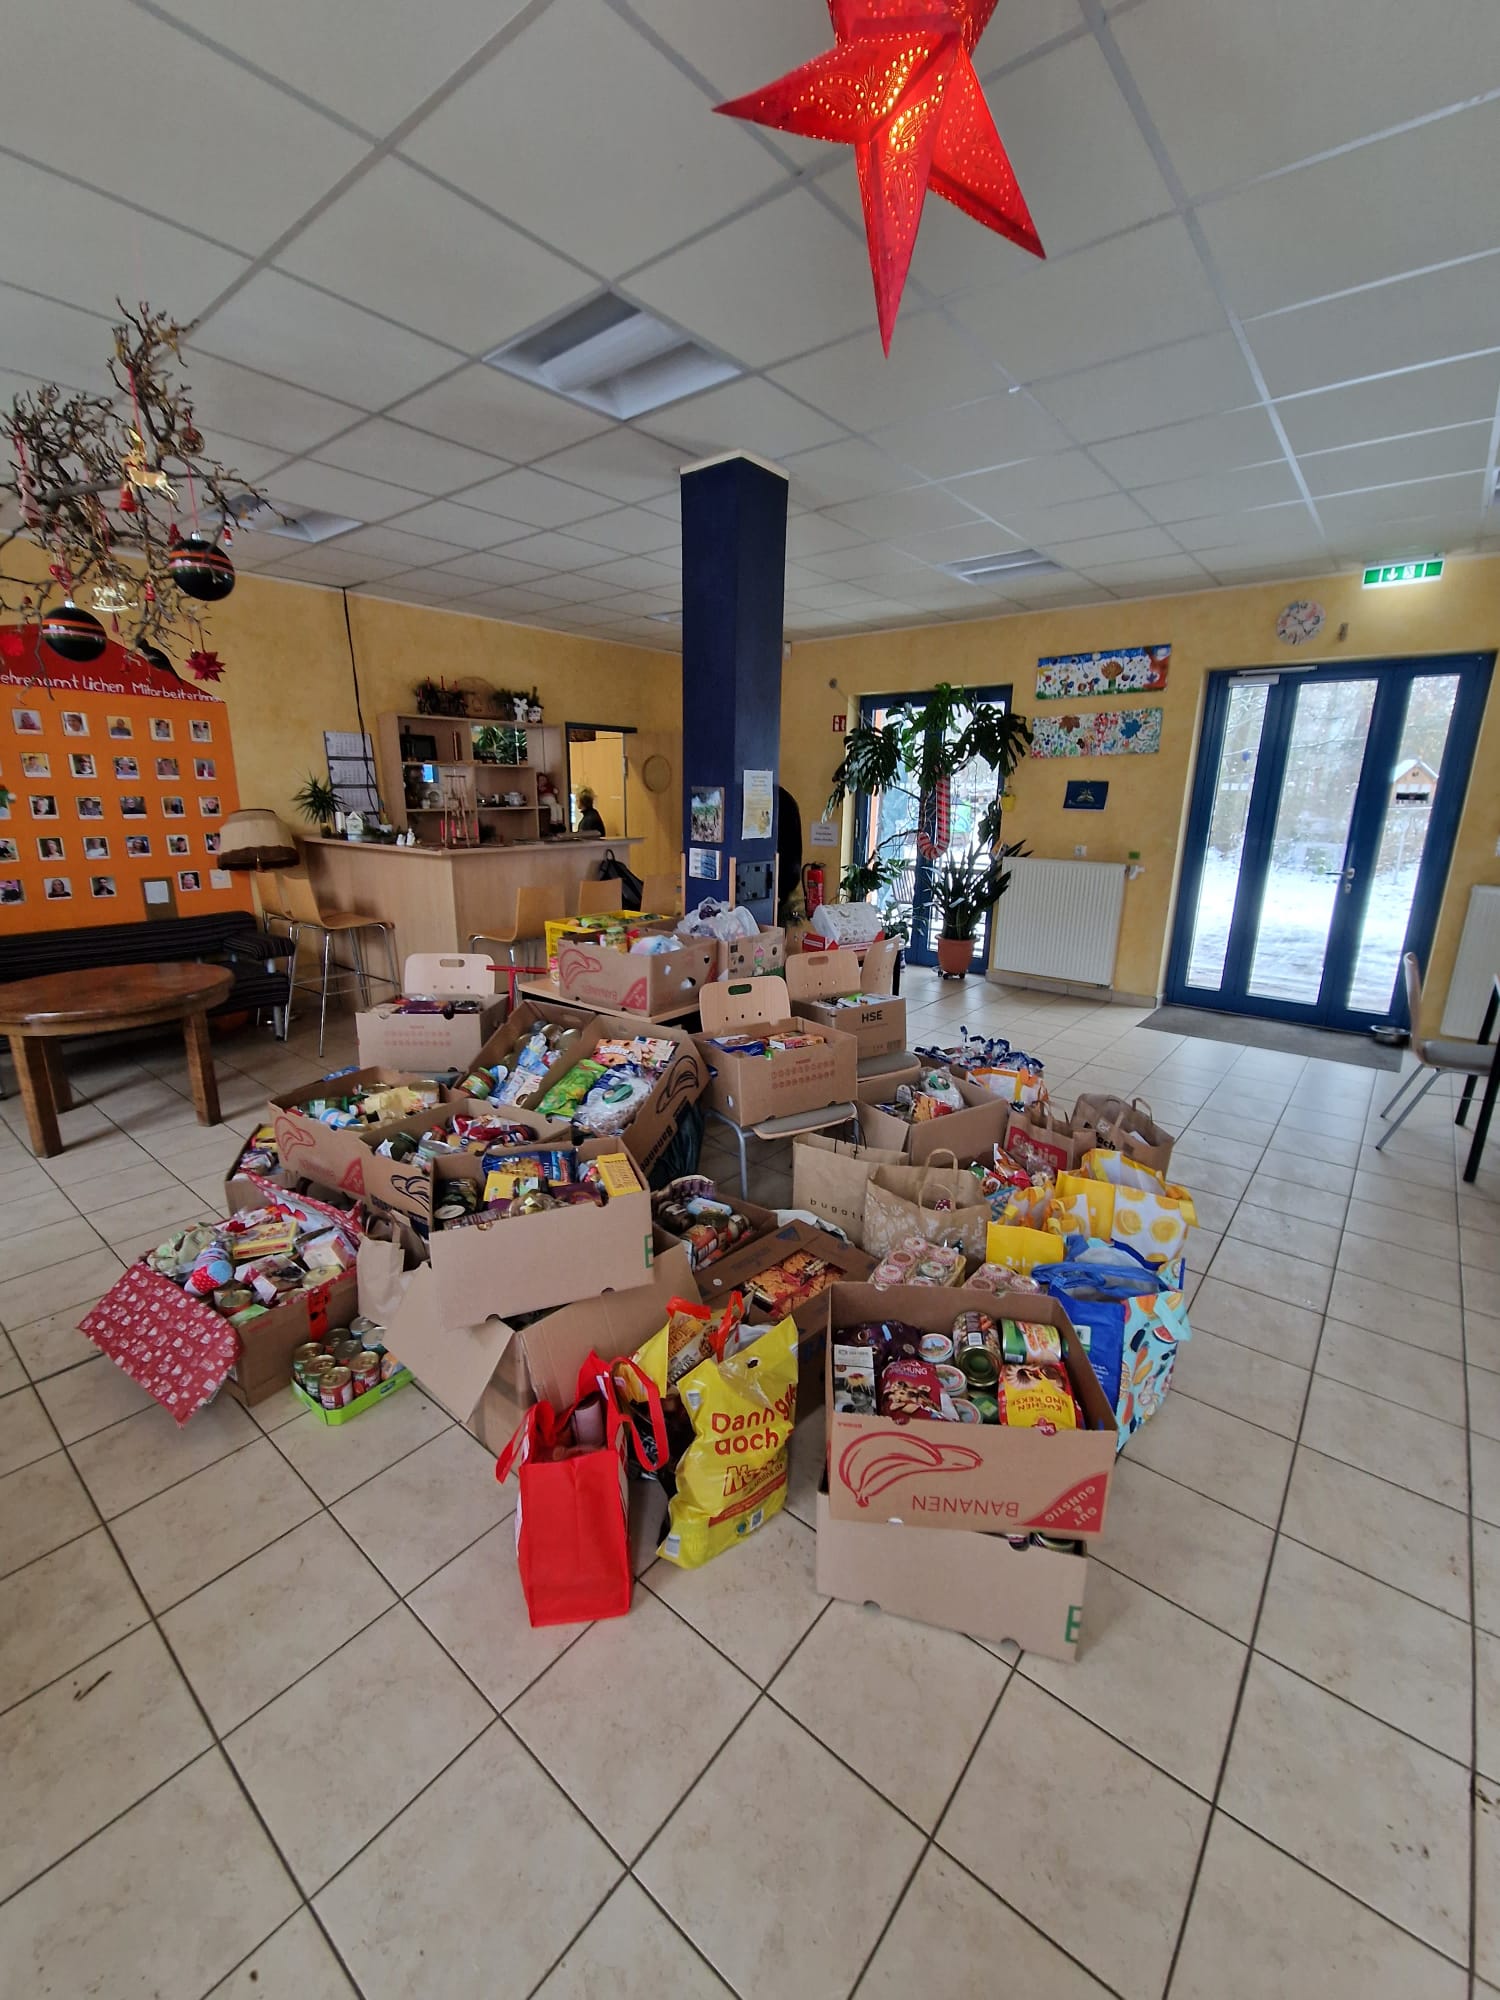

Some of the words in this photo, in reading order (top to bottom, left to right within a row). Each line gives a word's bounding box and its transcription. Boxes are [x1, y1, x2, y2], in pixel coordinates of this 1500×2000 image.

[861, 1009, 883, 1025] HSE
[809, 1197, 863, 1222] bugatt
[1017, 1401, 1063, 1414] KUCHEN
[711, 1406, 776, 1435] Dann
[912, 1494, 1020, 1518] BANANEN
[1072, 1506, 1098, 1527] GUT
